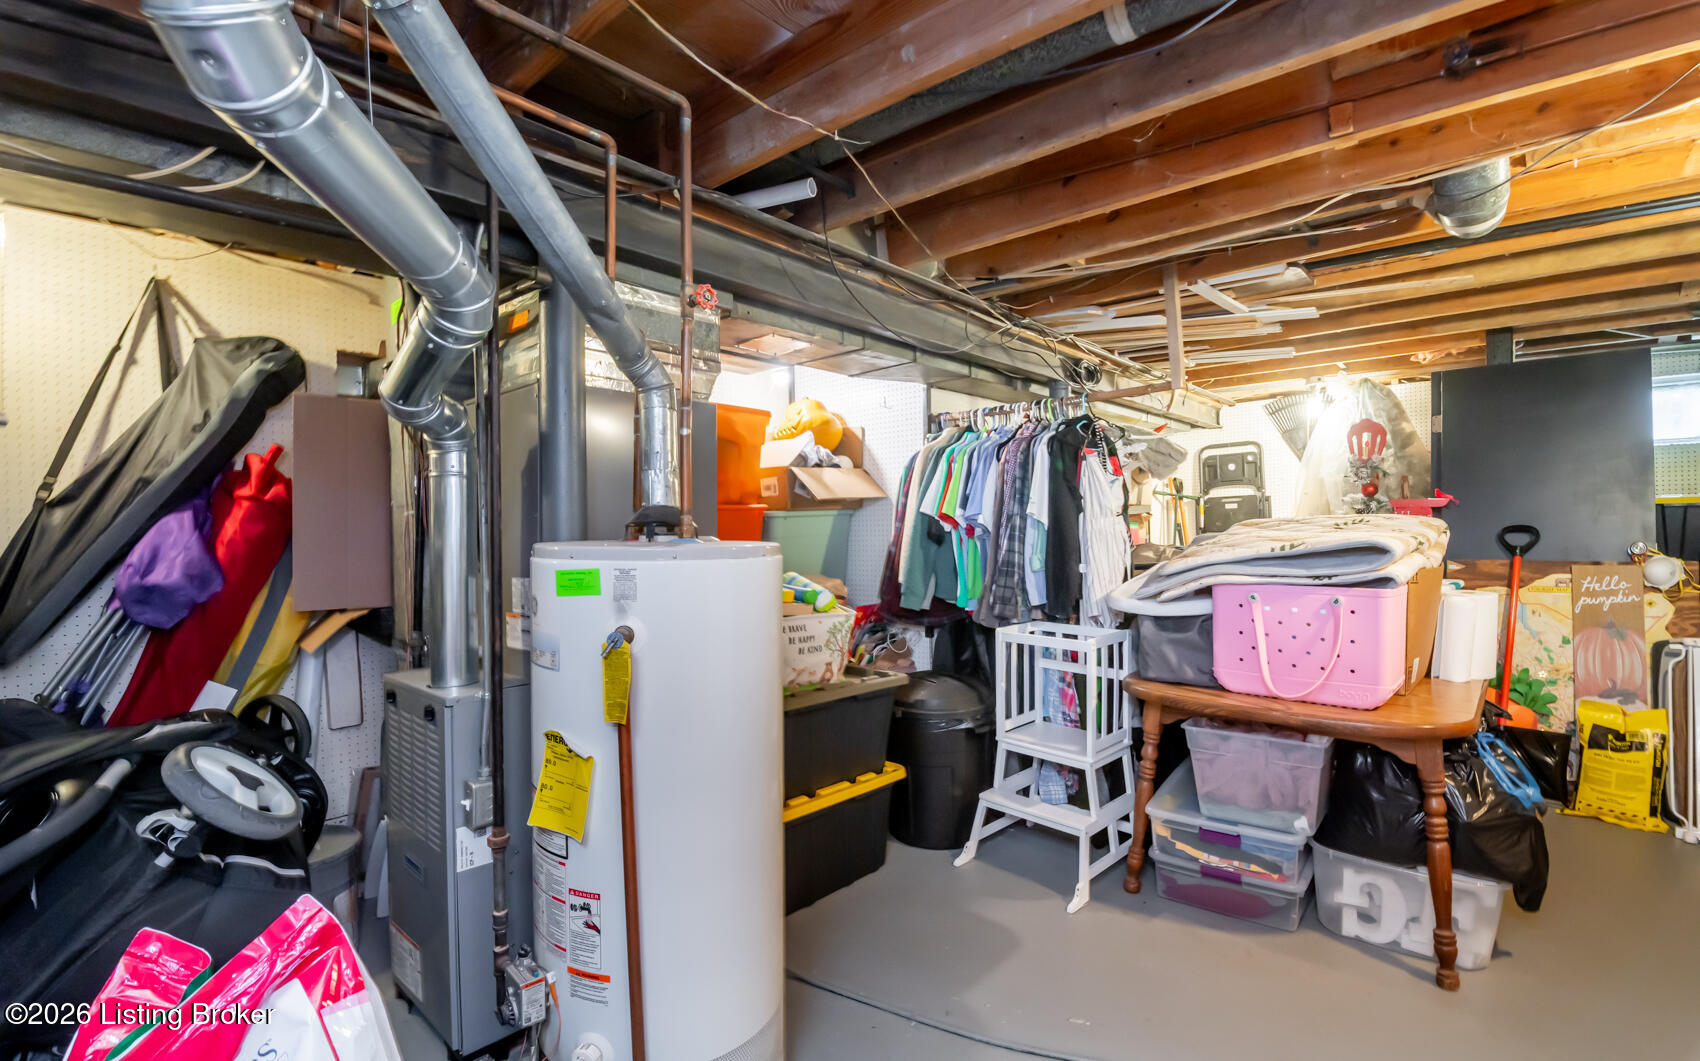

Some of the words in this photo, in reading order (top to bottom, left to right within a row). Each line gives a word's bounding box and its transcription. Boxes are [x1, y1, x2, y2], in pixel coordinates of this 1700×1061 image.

[1581, 575, 1632, 592] Hello
[1575, 590, 1641, 613] pumpkin
[788, 624, 807, 633] BRAVE
[788, 637, 796, 645] BE
[798, 635, 815, 643] HAPPY
[798, 647, 805, 655] BE
[807, 645, 823, 654] KIND
